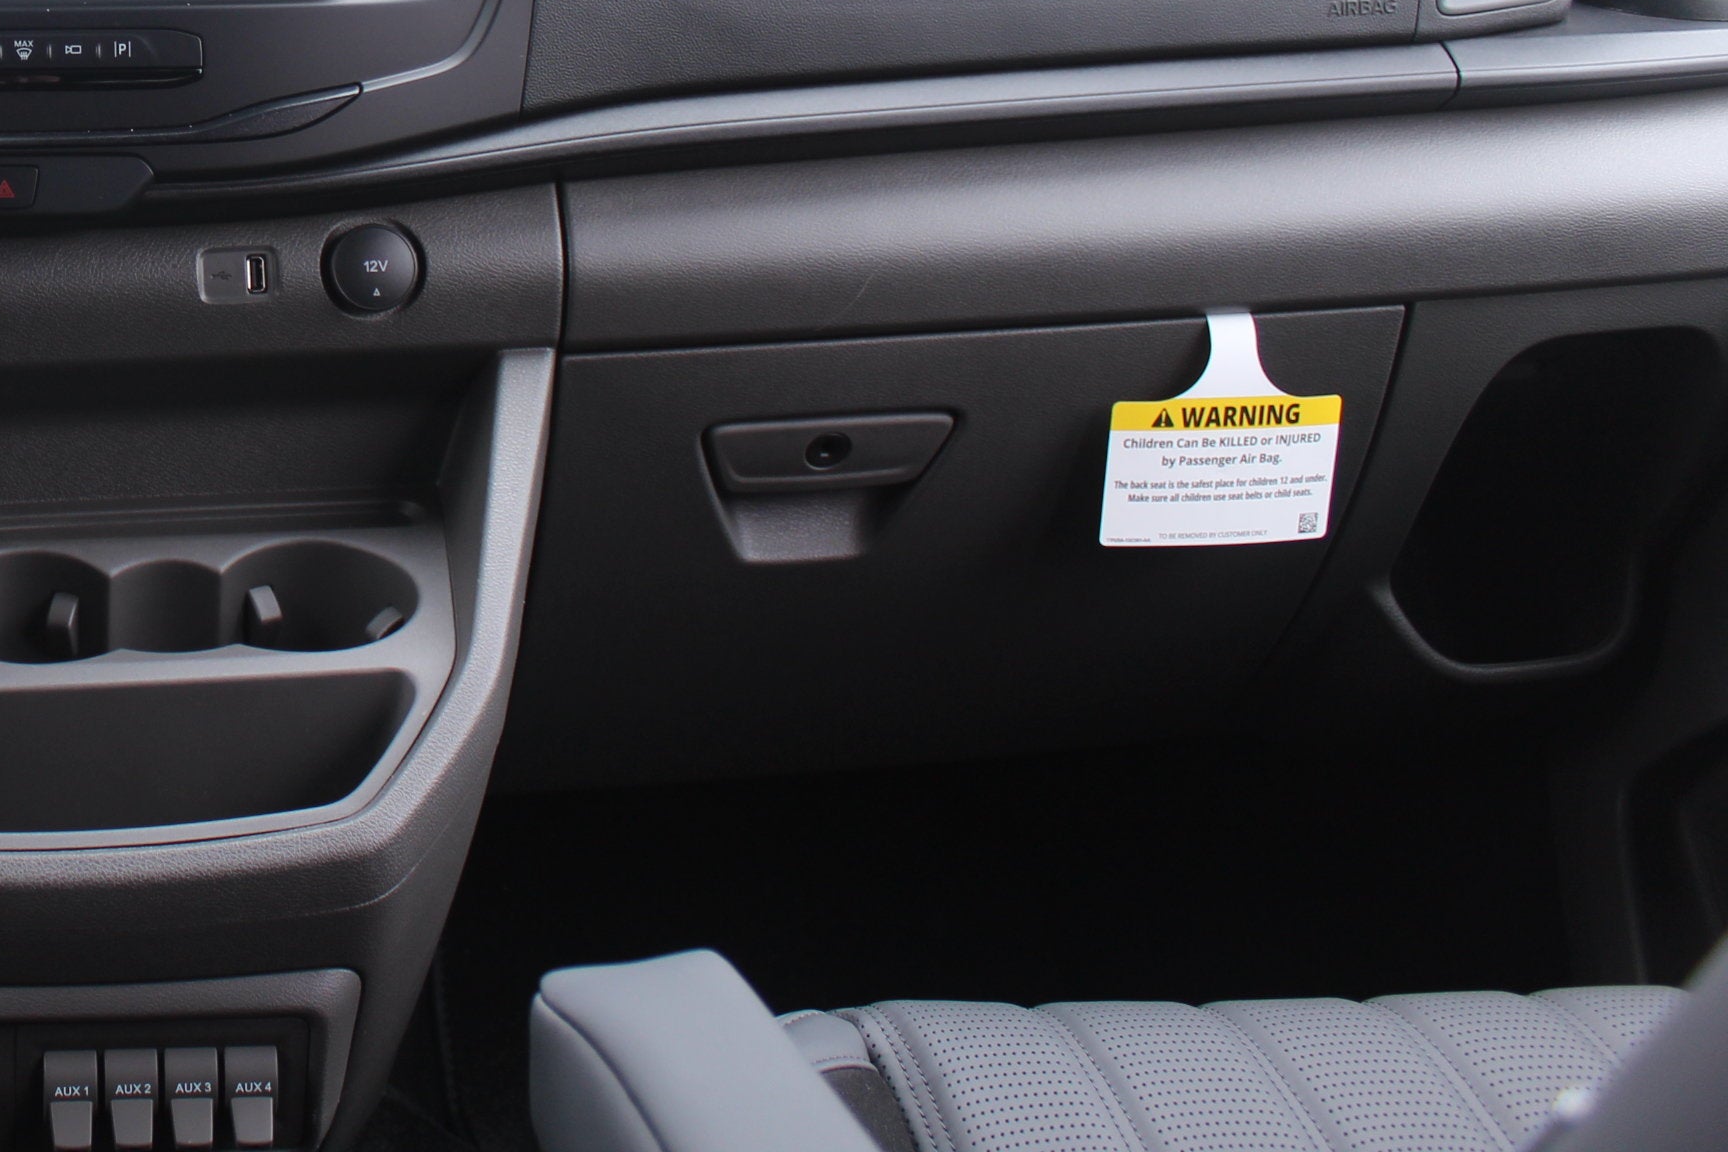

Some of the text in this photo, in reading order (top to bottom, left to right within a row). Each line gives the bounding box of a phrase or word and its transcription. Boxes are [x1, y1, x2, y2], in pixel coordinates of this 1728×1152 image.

[13, 40, 34, 48] MAX
[363, 259, 389, 273] 12V
[1181, 403, 1301, 428] WARNING
[1123, 433, 1322, 449] Children Can Be KILLED or INJURED
[1161, 453, 1283, 468] by Passenger Air Bag.
[1114, 473, 1328, 489] The back seat is the safest place for children 12 and under.
[1127, 494, 1150, 503] Make
[1151, 494, 1168, 503] sure
[1169, 493, 1180, 502] all
[1181, 493, 1211, 502] children
[1228, 492, 1244, 501] seat
[1245, 491, 1263, 500] belts
[1264, 491, 1273, 499] or
[1274, 489, 1291, 499] child
[54, 1086, 89, 1097] AUX 1
[115, 1083, 152, 1095] AUX 2
[175, 1082, 212, 1094] AUX 3
[235, 1082, 272, 1093] AUX 4
